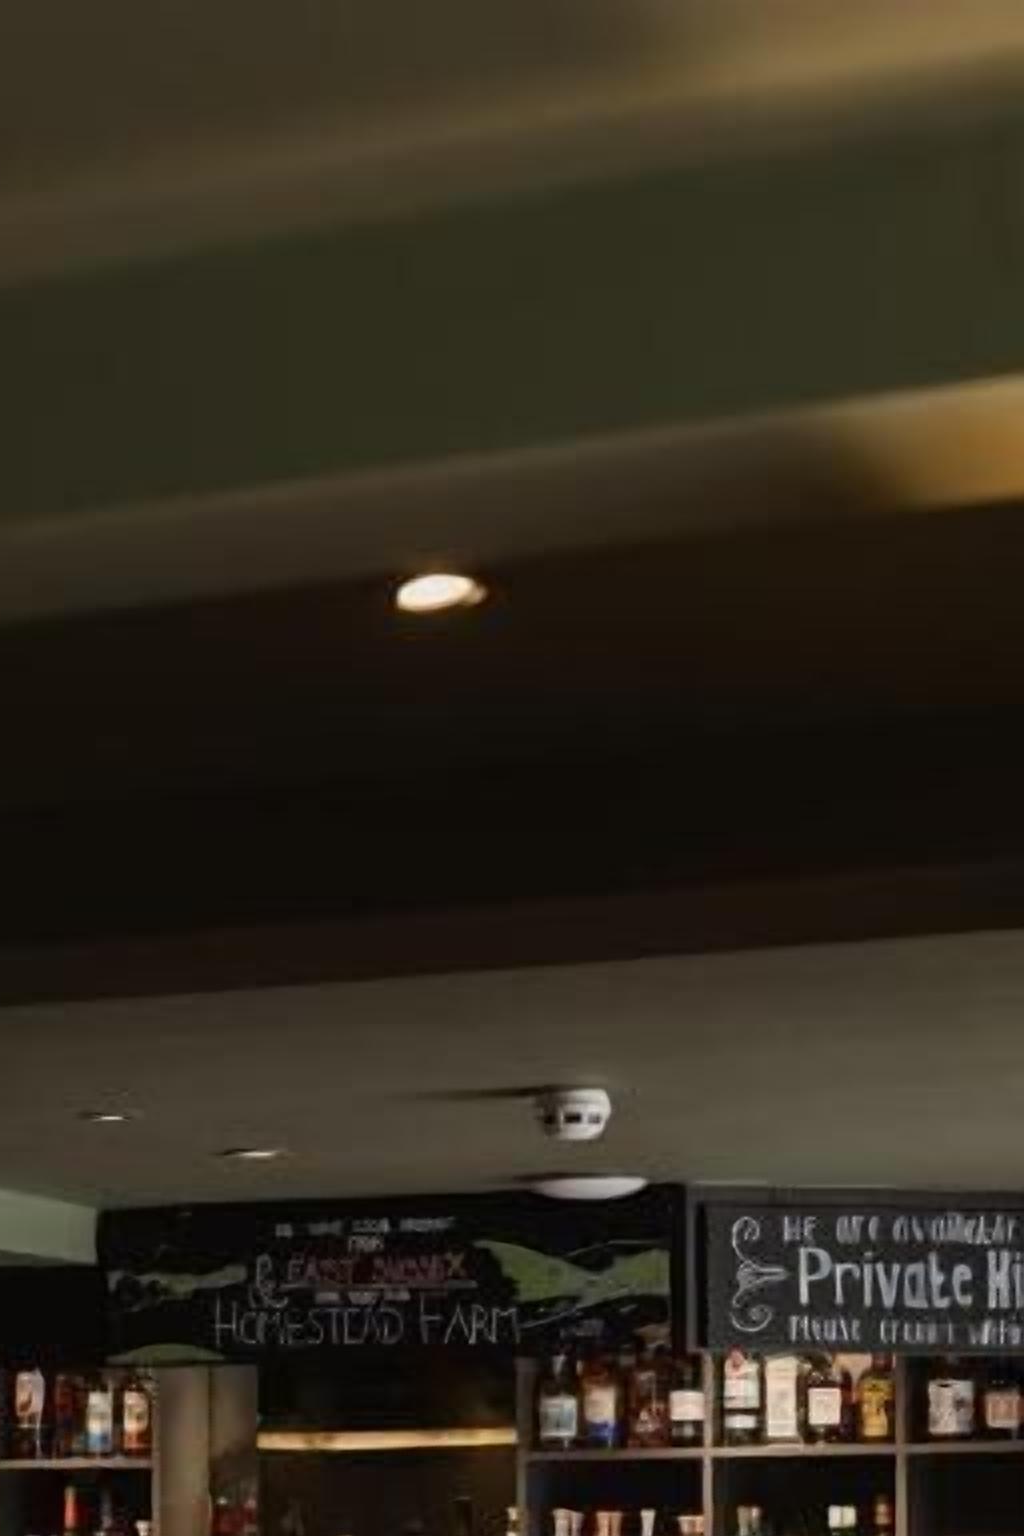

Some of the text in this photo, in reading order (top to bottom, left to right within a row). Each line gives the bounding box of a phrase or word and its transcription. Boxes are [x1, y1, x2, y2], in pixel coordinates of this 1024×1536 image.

[798, 1246, 973, 1309] Private
[213, 1293, 522, 1346] HOMESTEAD FARM
